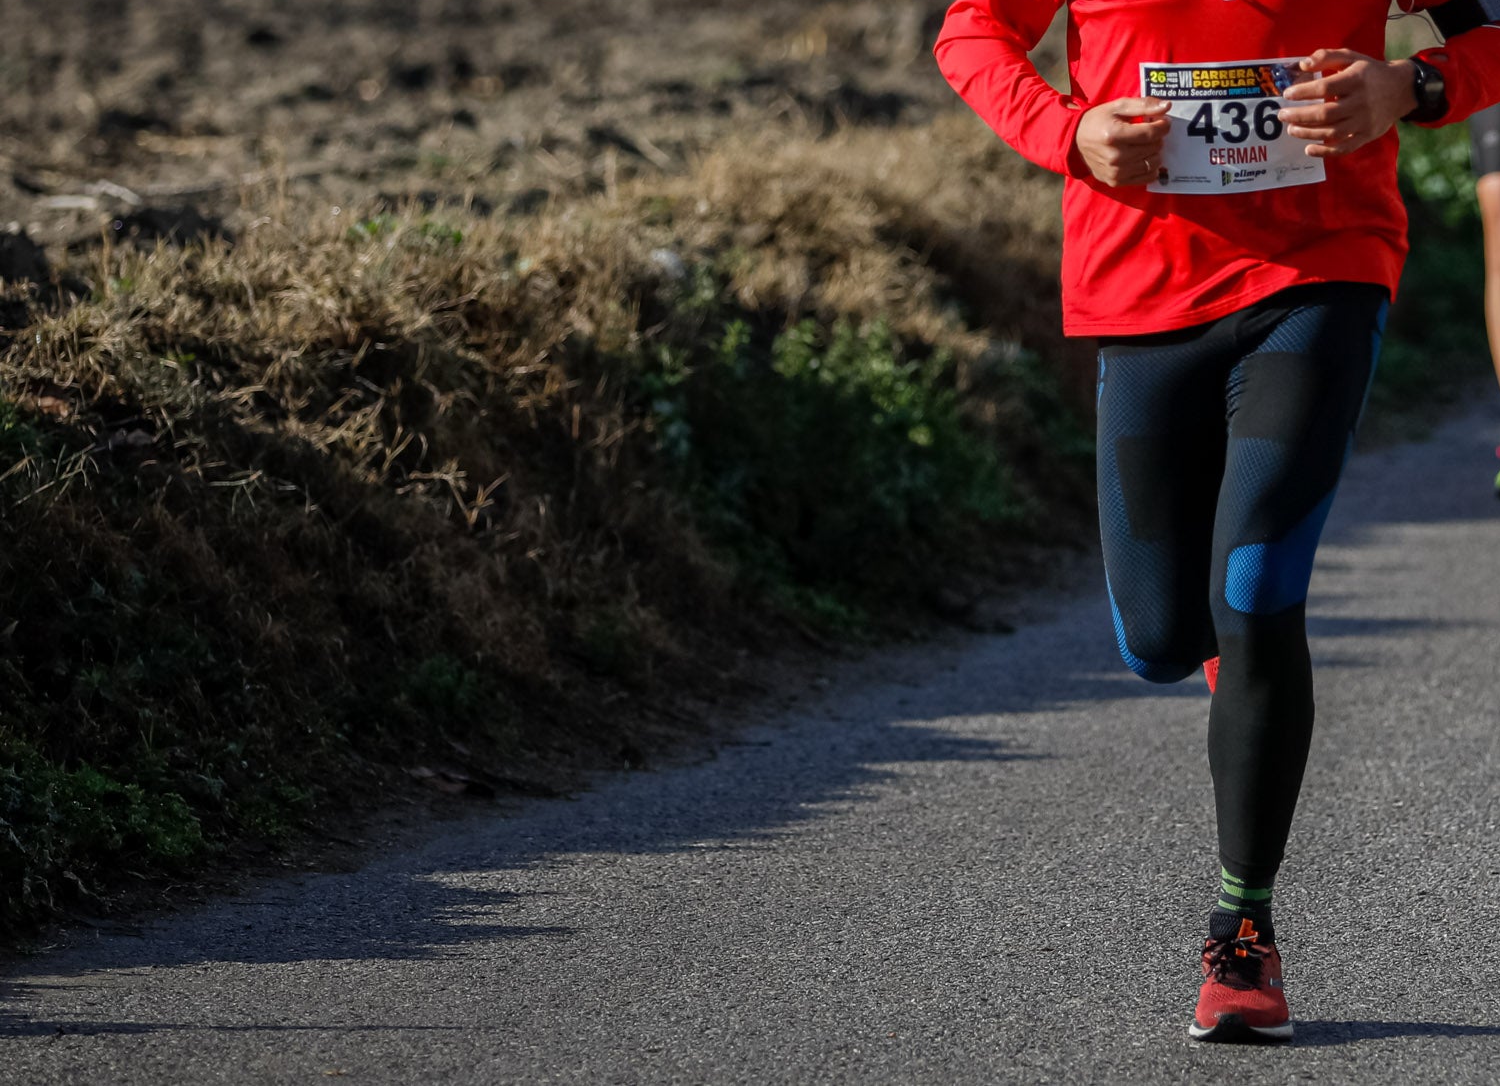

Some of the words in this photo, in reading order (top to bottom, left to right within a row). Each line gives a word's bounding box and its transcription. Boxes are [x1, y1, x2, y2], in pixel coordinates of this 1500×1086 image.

[1150, 71, 1166, 83] 26
[1178, 70, 1193, 88] VII
[1192, 68, 1255, 80] CARRERA
[1193, 78, 1256, 88] POPULAR
[1151, 88, 1167, 97] Ruta
[1167, 88, 1177, 97] de
[1178, 88, 1189, 97] los
[1190, 88, 1228, 96] Secaderos
[1187, 100, 1283, 144] 436
[1209, 145, 1268, 166] GERMAN
[1234, 168, 1267, 178] olimpo
